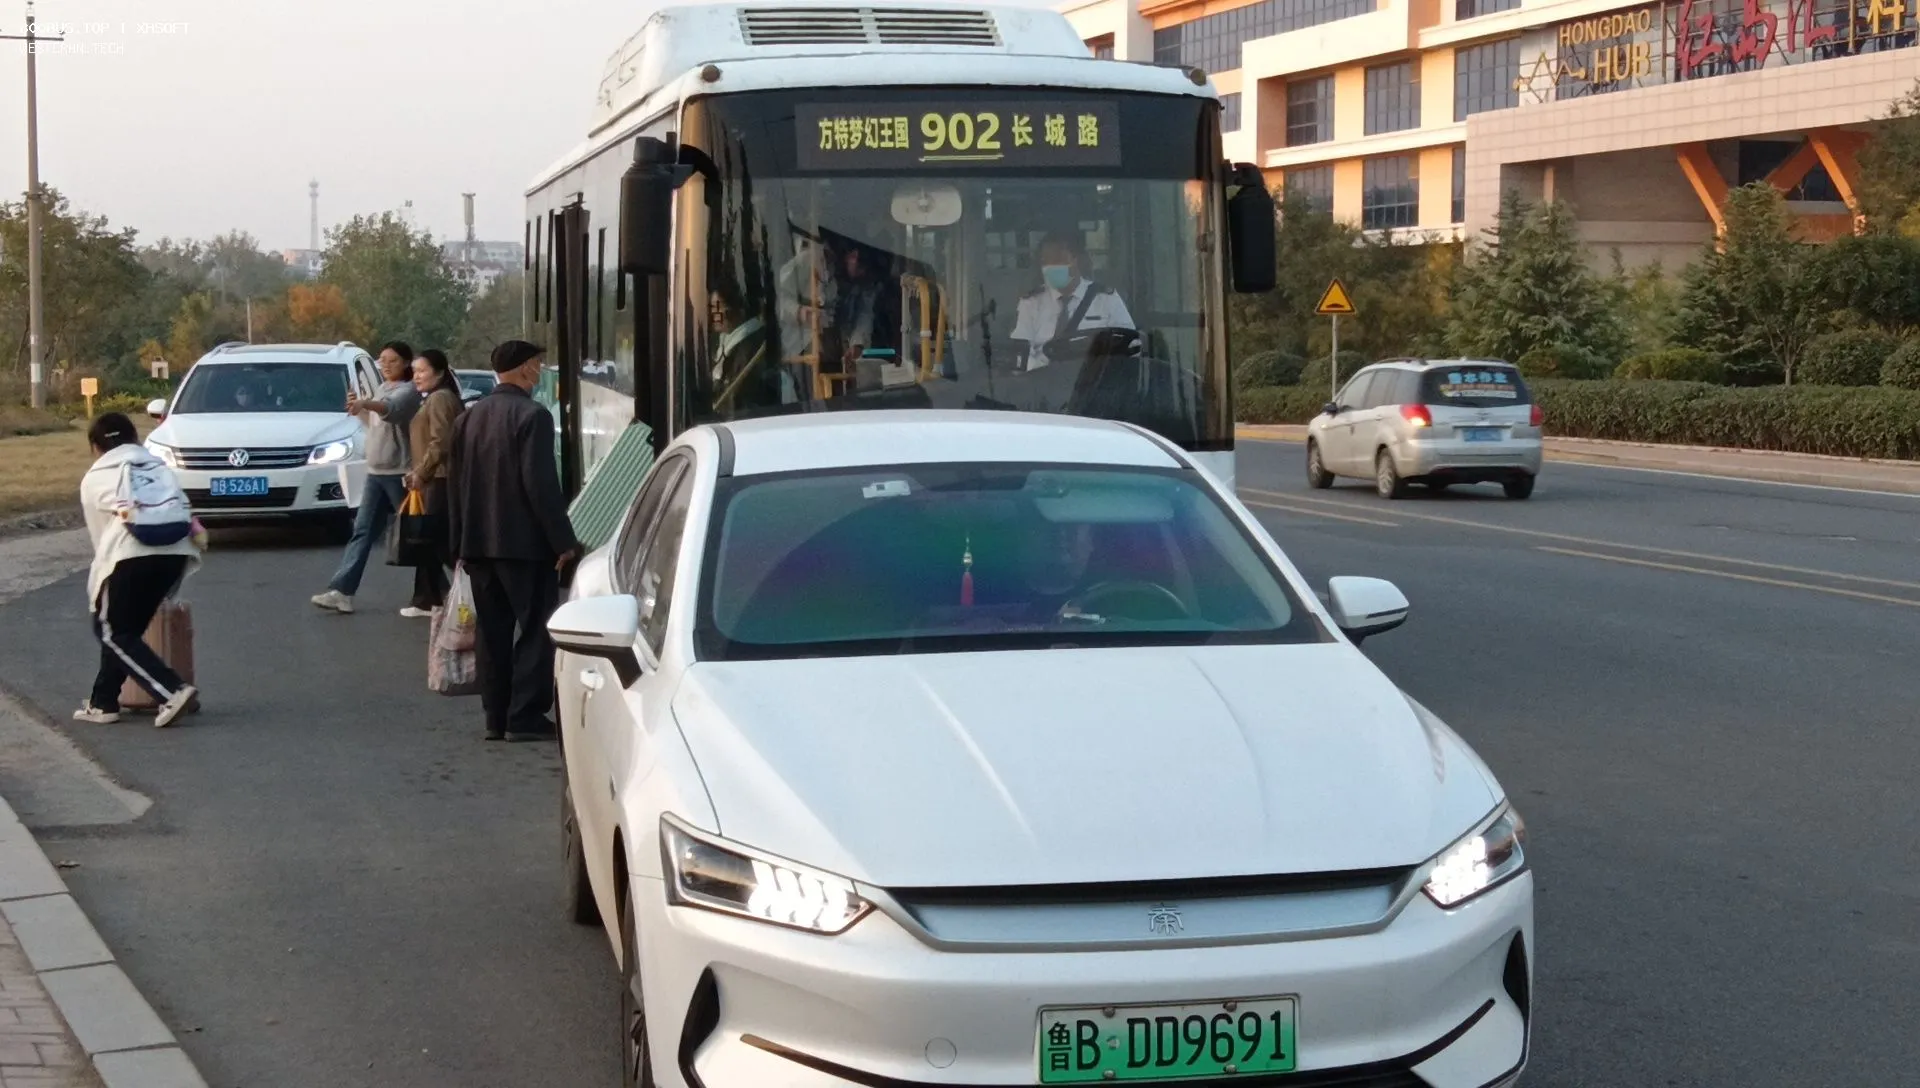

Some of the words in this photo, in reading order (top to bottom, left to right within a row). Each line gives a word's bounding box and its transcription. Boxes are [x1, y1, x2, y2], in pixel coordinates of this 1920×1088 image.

[1560, 8, 1651, 47] HONGDAO
[1593, 40, 1651, 84] HUB
[818, 115, 910, 150] 方特梦幻王国
[920, 112, 1001, 150] 902
[1011, 114, 1099, 147] 长城路
